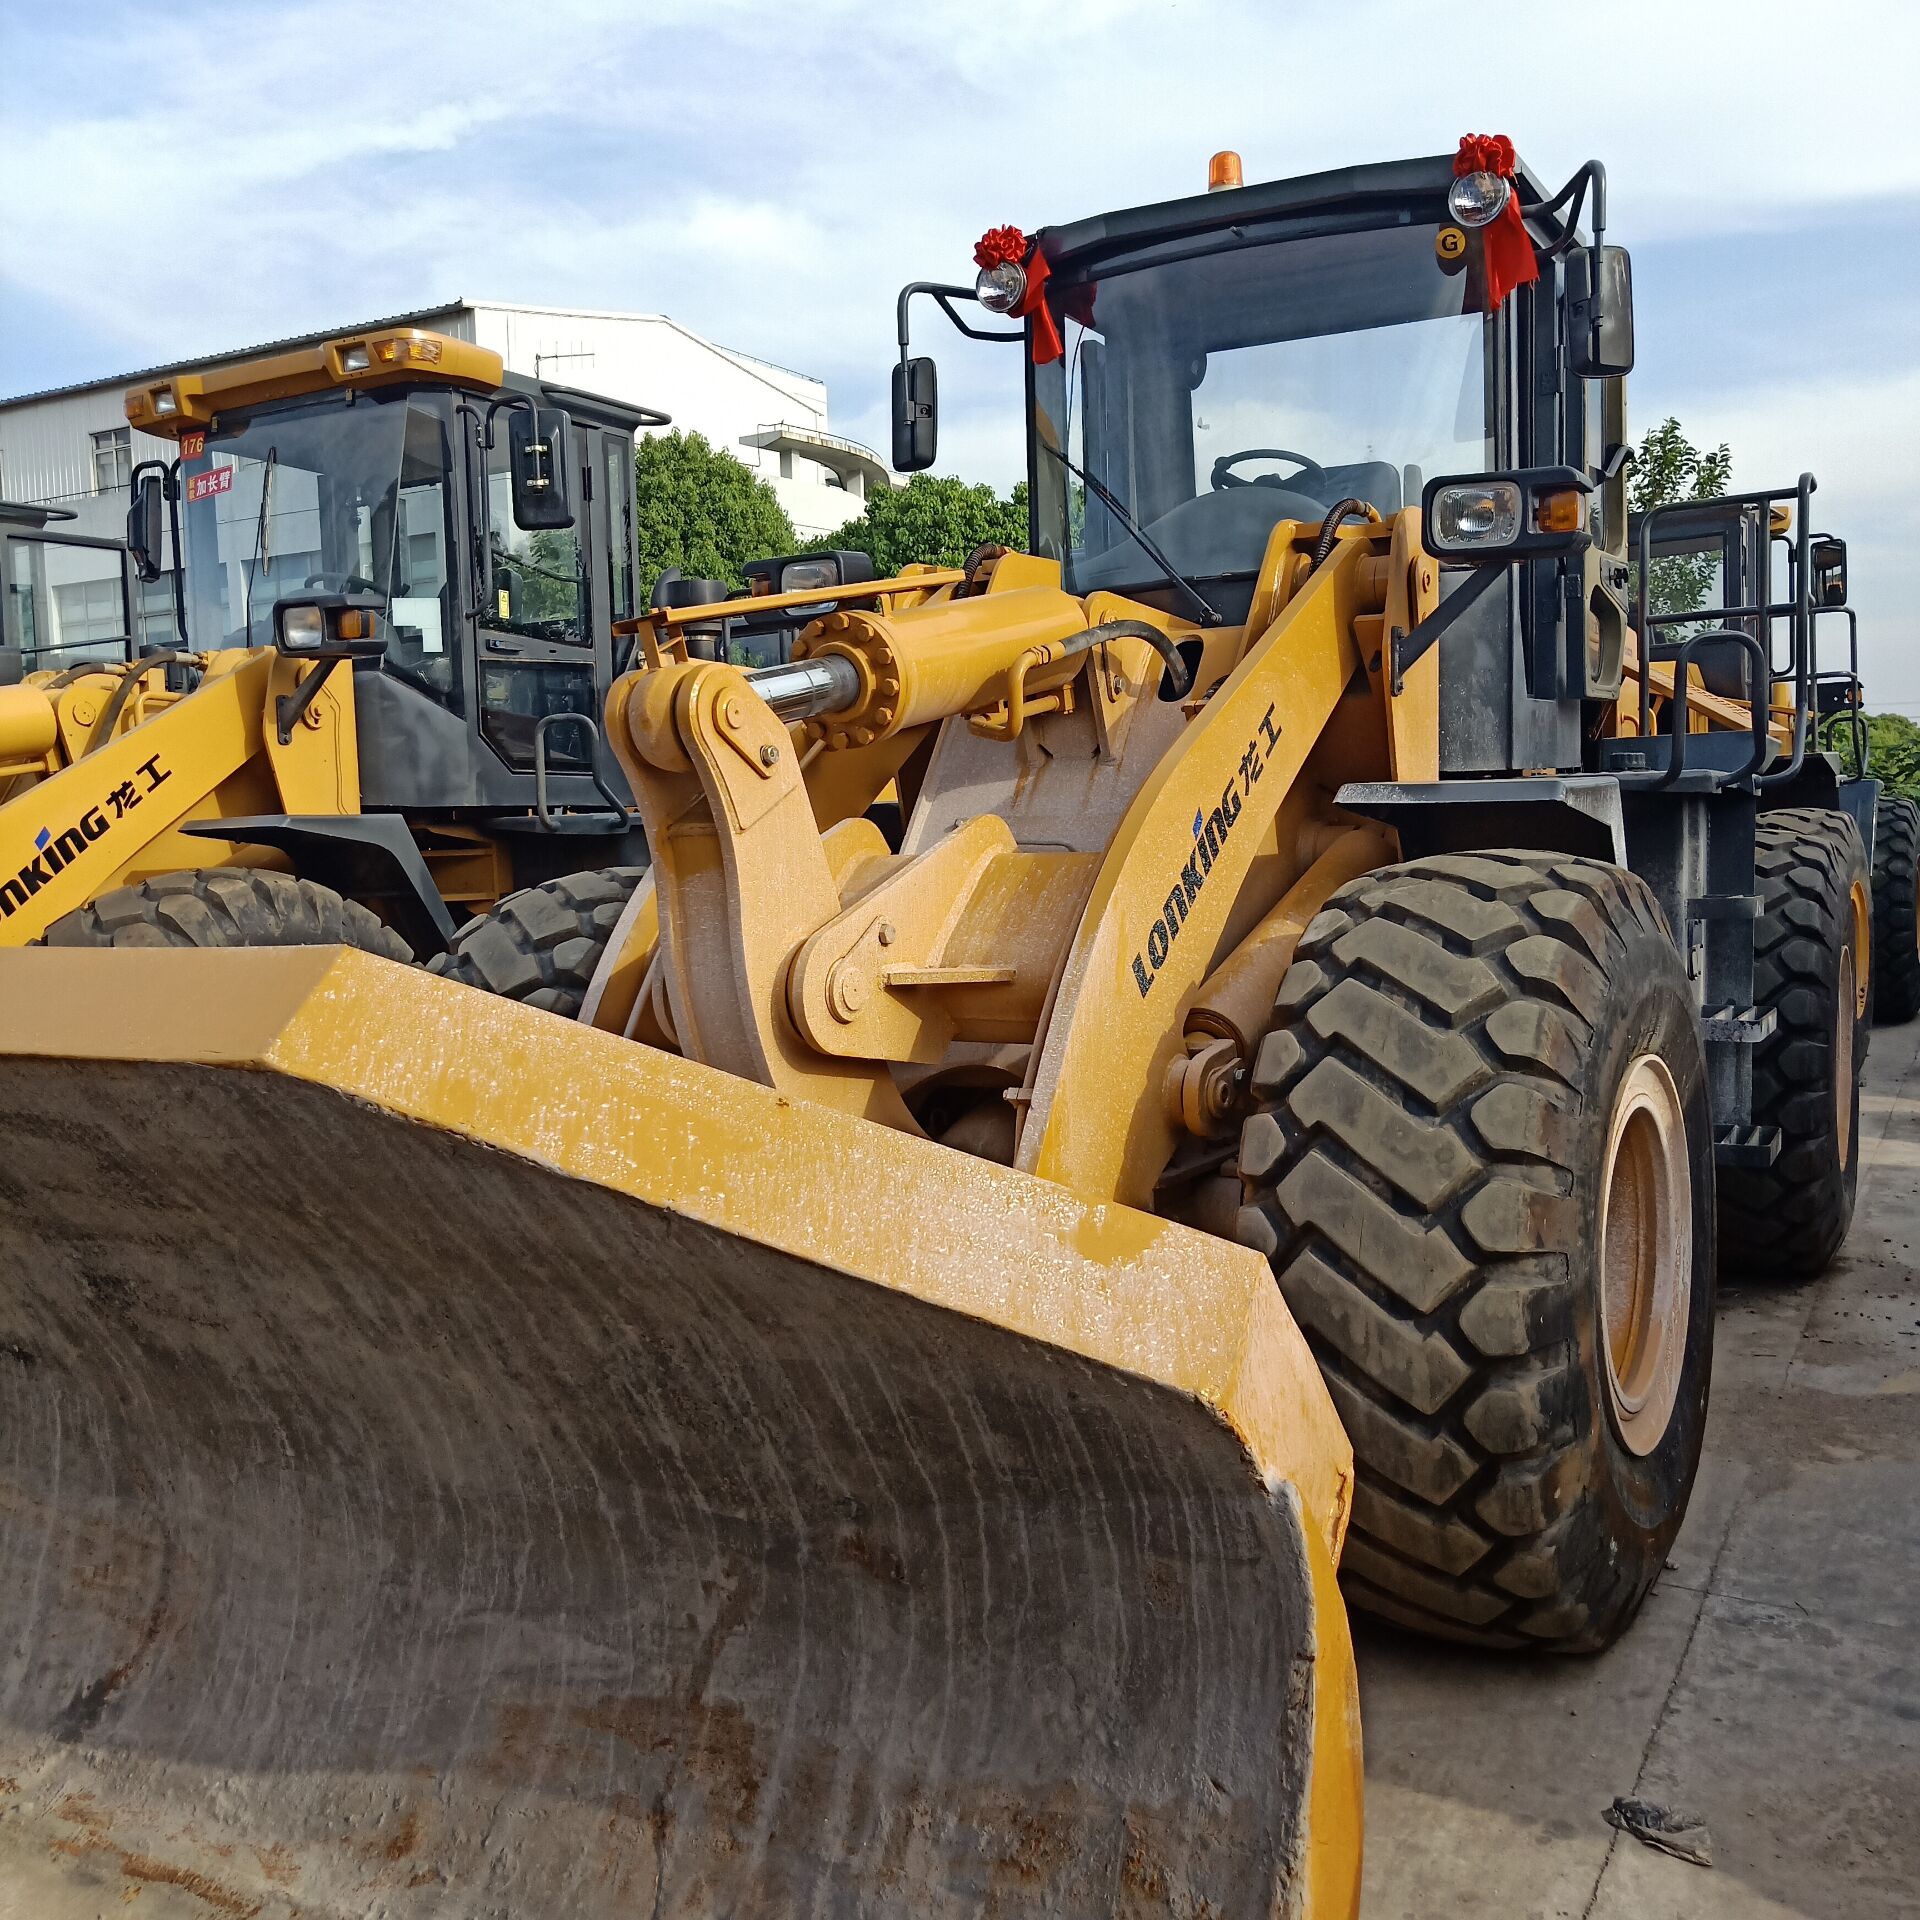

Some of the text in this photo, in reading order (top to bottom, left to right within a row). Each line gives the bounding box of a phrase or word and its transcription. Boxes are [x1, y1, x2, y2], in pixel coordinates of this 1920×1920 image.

[1441, 233, 1458, 251] G
[182, 437, 204, 455] 176
[196, 470, 231, 496] 加长臂
[0, 752, 173, 923] NKING 龙工
[1131, 701, 1283, 999] LONKING 龙工
